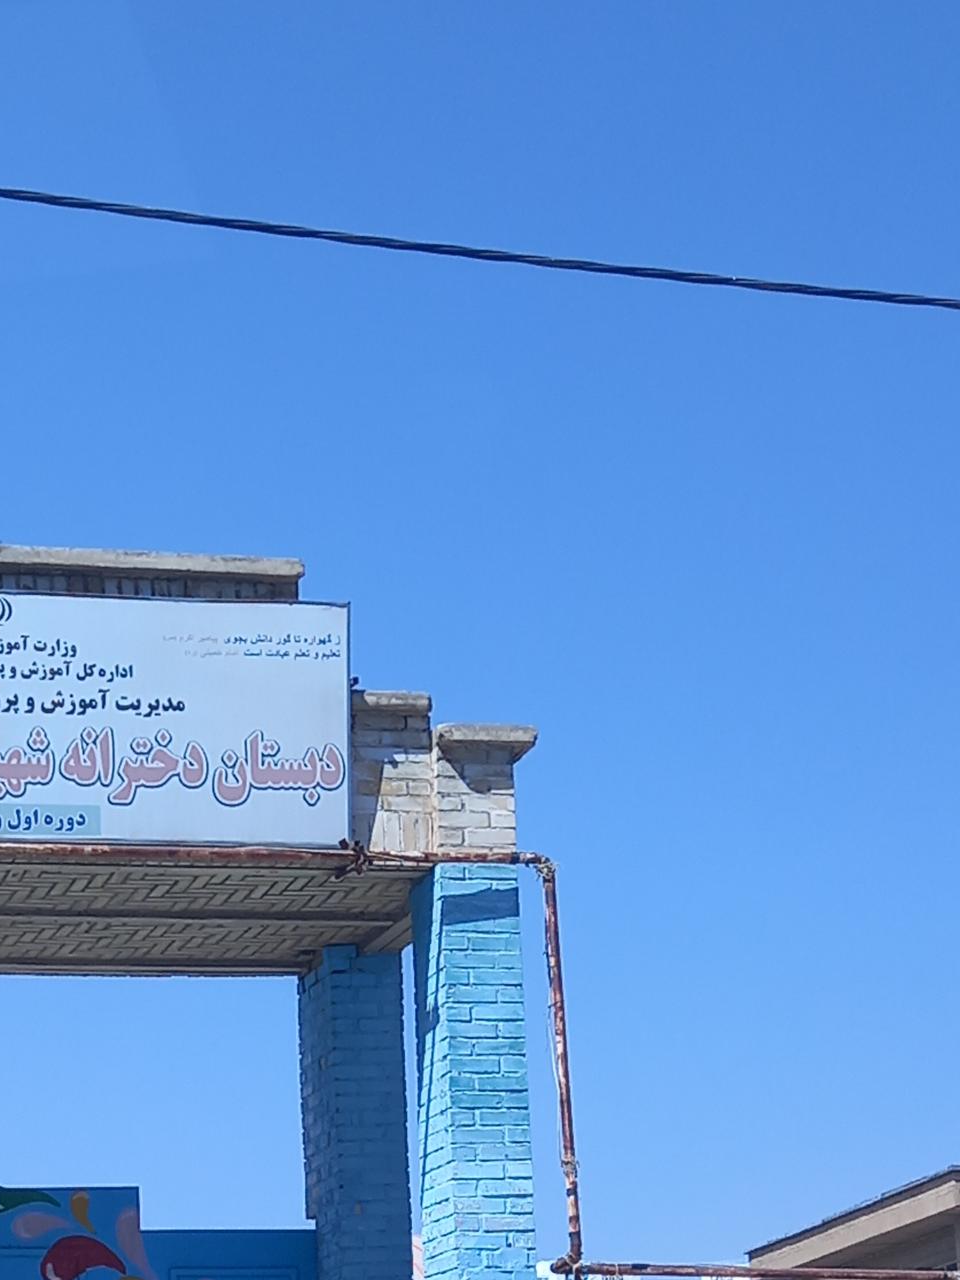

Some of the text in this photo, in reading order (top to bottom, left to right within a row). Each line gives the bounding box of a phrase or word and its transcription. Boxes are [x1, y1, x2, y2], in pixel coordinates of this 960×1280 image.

[33, 638, 78, 658] وزارت
[250, 633, 273, 646] دانش
[276, 633, 291, 646] گور
[293, 634, 302, 644] تا
[243, 649, 262, 658] است
[313, 650, 319, 660] و
[8, 665, 17, 679] و
[20, 661, 72, 681] آموزش
[76, 662, 97, 682] کل
[98, 663, 134, 683] اداره
[24, 695, 35, 713] و
[40, 689, 111, 716] آموزش
[115, 696, 186, 717] مدیریت
[59, 725, 209, 806] دخترانه
[213, 729, 345, 807] دبستان
[7, 808, 40, 832] اول
[43, 811, 87, 832] دوره
